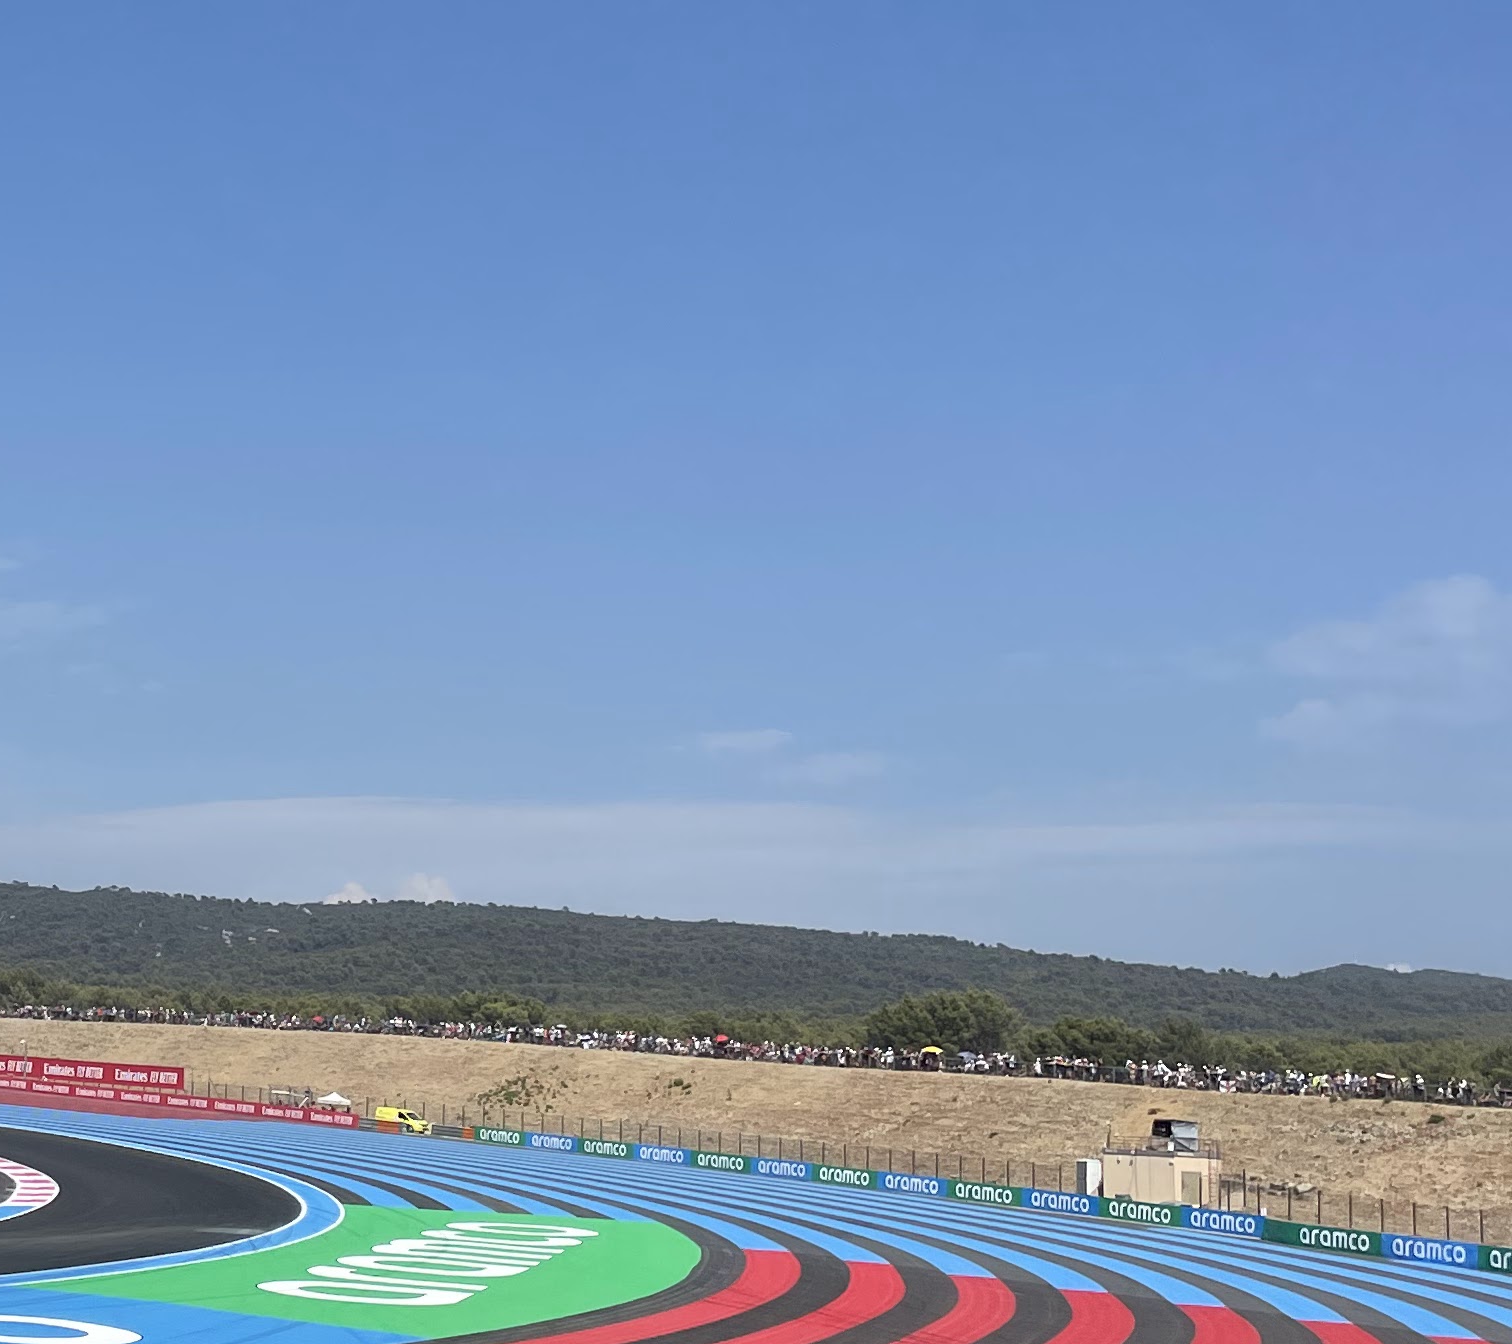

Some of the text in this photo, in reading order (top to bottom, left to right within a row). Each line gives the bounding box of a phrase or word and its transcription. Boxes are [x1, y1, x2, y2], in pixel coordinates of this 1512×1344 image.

[480, 1129, 519, 1143] aramco
[532, 1135, 572, 1151] aramco
[584, 1141, 626, 1156] aramco
[640, 1146, 684, 1162] aramco
[698, 1154, 743, 1170] aramco
[758, 1161, 805, 1177] aramco
[820, 1167, 869, 1185] aramco
[886, 1175, 938, 1195] aramco
[956, 1183, 1012, 1204] aramco
[1032, 1192, 1089, 1212] aramco
[1109, 1202, 1170, 1223] aramco
[1191, 1211, 1255, 1233] aramco
[1300, 1228, 1369, 1251] aramco
[1393, 1239, 1465, 1263] aramco
